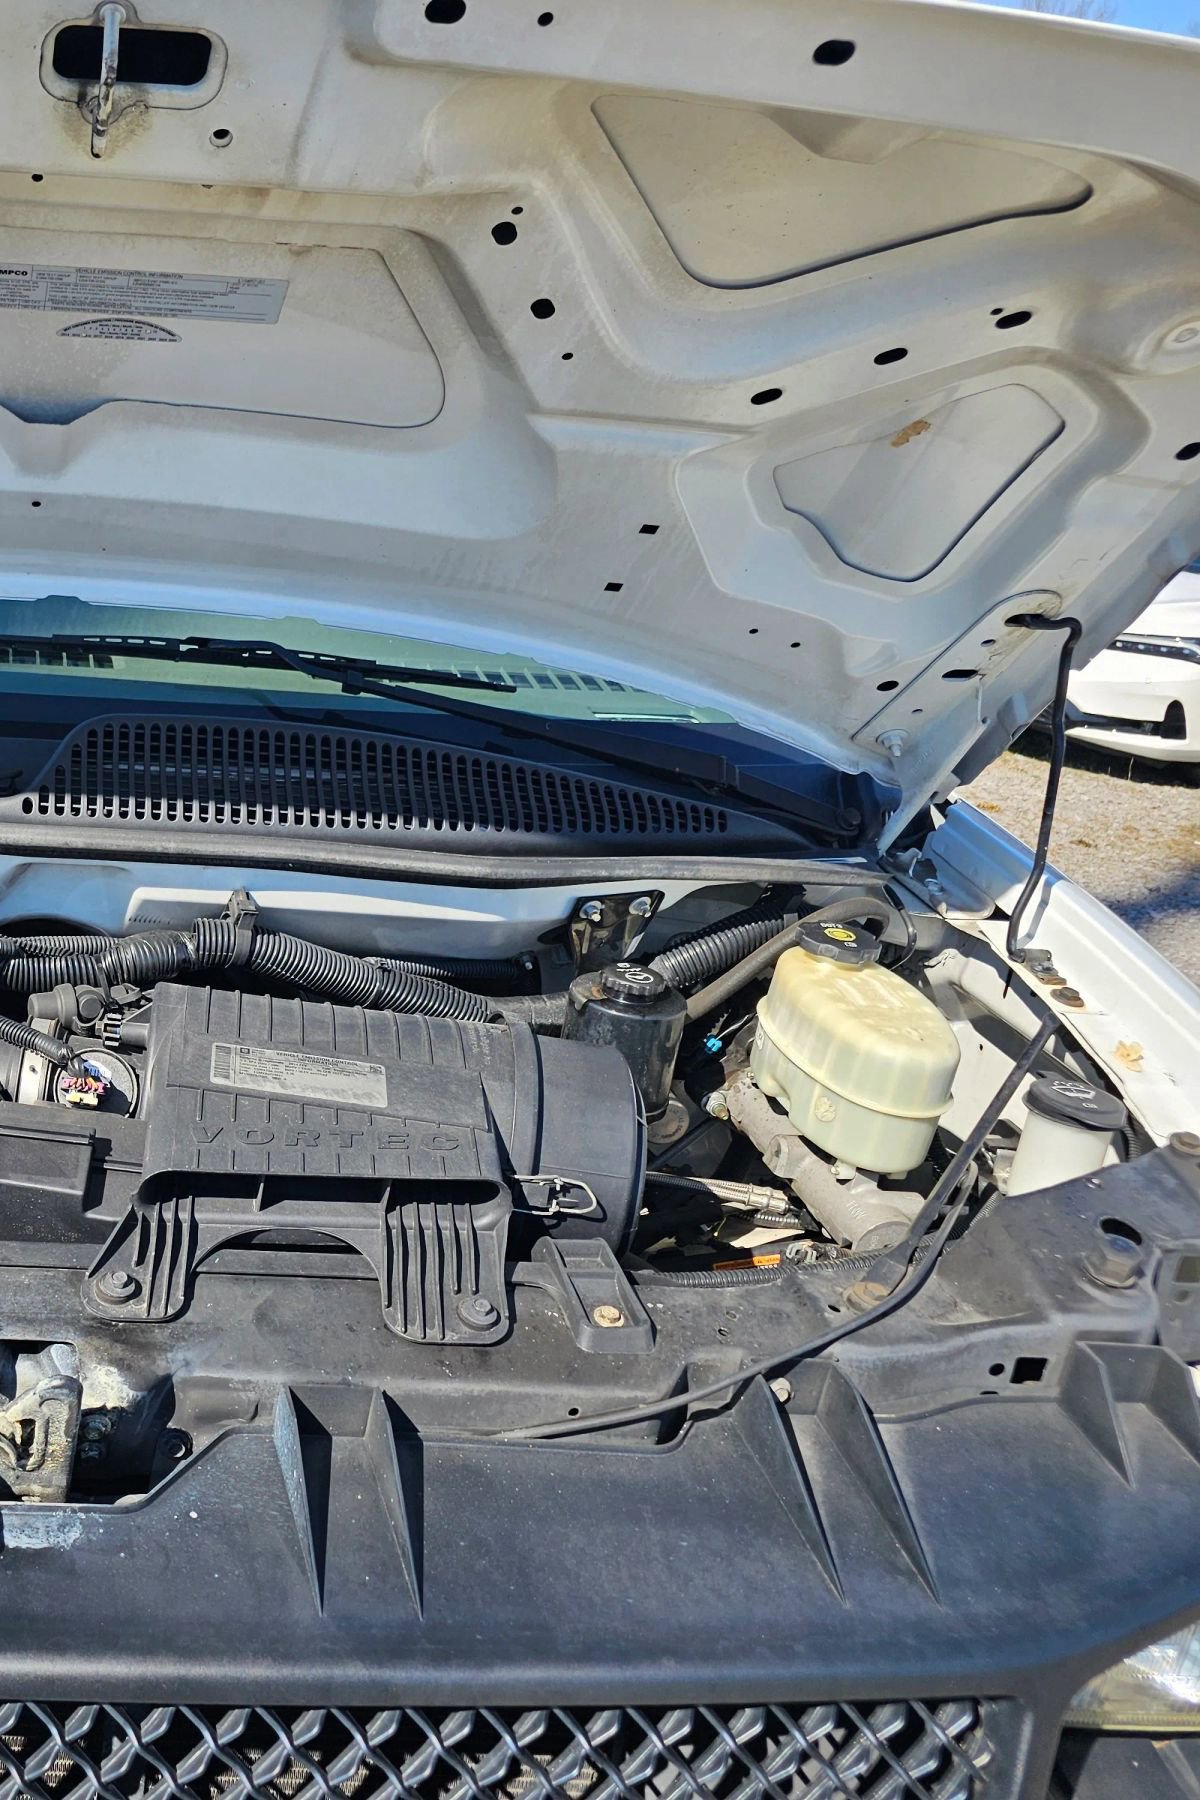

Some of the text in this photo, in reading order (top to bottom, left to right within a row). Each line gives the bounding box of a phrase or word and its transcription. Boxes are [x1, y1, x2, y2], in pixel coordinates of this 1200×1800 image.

[276, 1051, 299, 1059] VEHICLE
[301, 1054, 330, 1063] EMISSION
[190, 1126, 460, 1151] VORTEC
